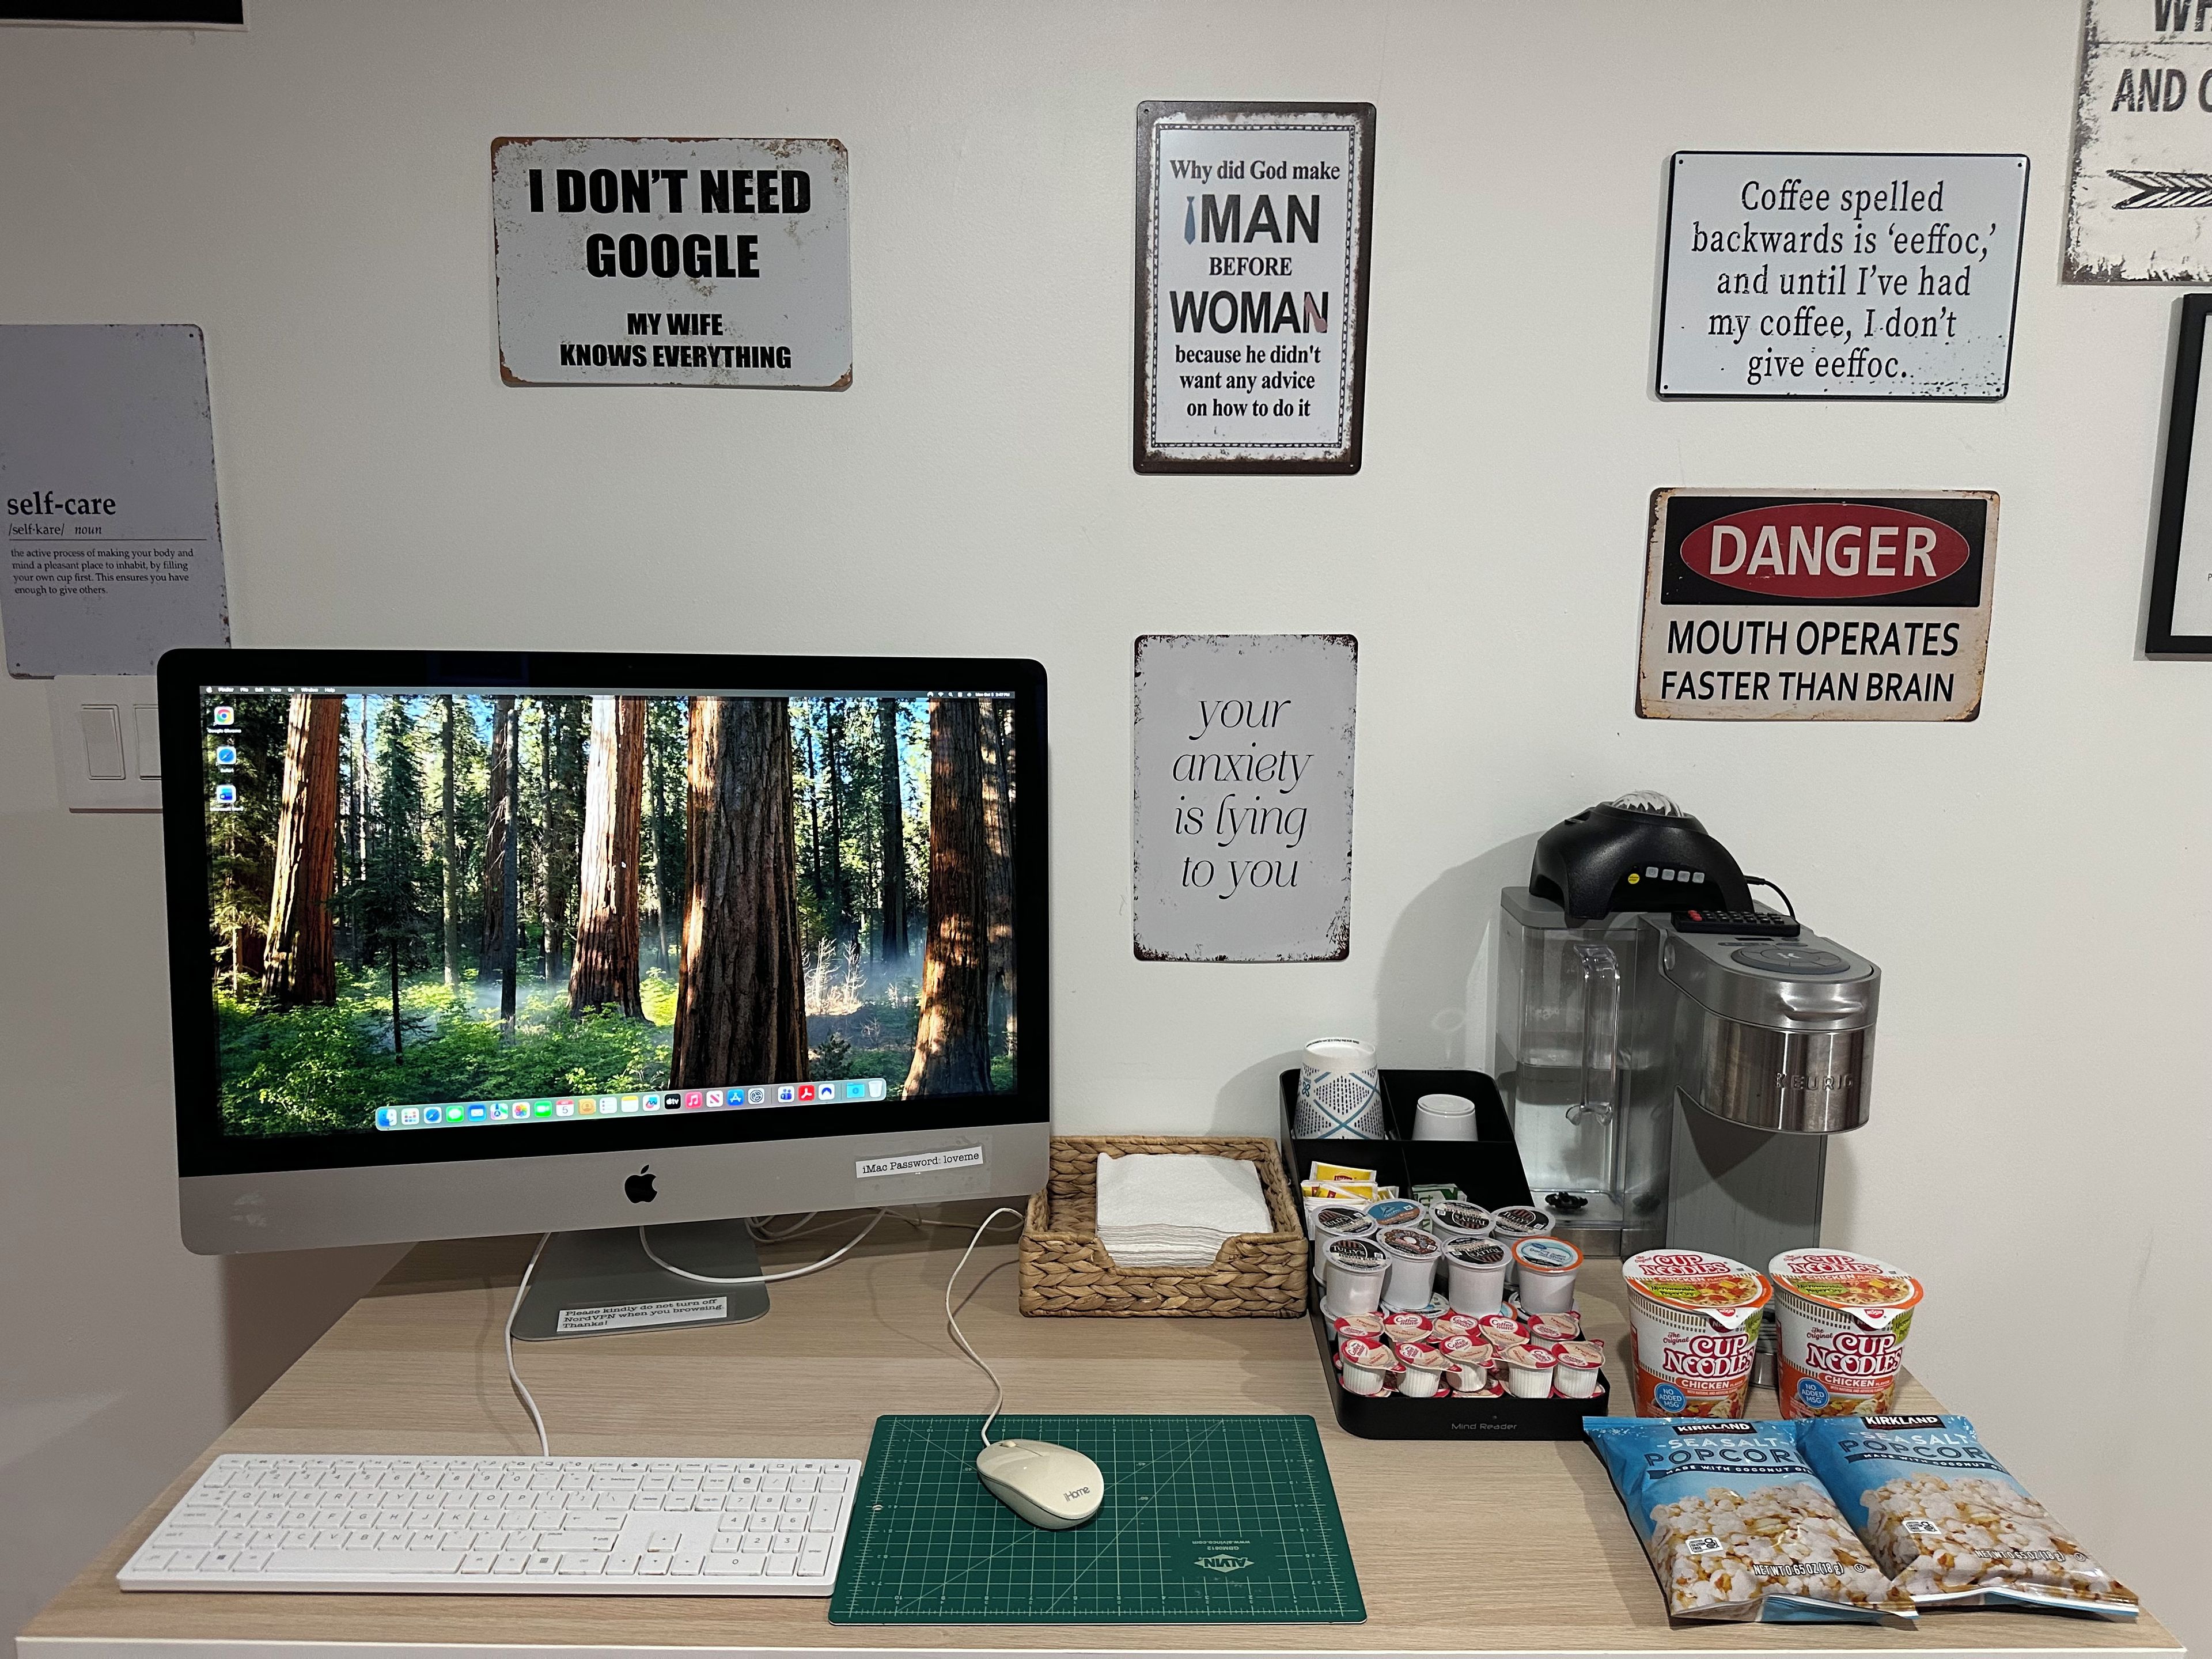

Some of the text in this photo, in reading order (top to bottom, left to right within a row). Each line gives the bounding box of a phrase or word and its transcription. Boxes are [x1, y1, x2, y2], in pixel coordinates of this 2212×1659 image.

[2111, 69, 2187, 112] AND
[1170, 160, 1340, 183] Why did God make
[529, 168, 810, 214] I DON'T NEED
[1741, 179, 1944, 220] Coffee spelled
[1202, 194, 1320, 243] MAN
[1692, 221, 1997, 262] backwards is 'eeffoc,'
[586, 234, 760, 278] GOOGLE
[1209, 257, 1292, 276] BEFORE
[1717, 264, 1971, 295] and until I've had
[1170, 291, 1328, 334] WOMAN
[628, 313, 724, 336] MY WIFE
[1709, 305, 1957, 344] my coffee, I don't
[560, 345, 791, 369] KNOWS EVERYTHING
[1175, 345, 1321, 363] because he didn't
[1747, 347, 1804, 385] give
[1180, 371, 1316, 393] want any advice
[1187, 399, 1310, 416] on how to do it
[7, 491, 116, 515] self-care
[75, 526, 102, 535] noun
[54, 551, 84, 559] process
[86, 548, 96, 557] of
[97, 549, 129, 559] making
[131, 551, 151, 559] your
[153, 549, 173, 559] body
[177, 548, 194, 557] and
[1709, 525, 1938, 577] DANGER
[44, 561, 79, 571] pleasant
[81, 562, 103, 571] place
[116, 562, 148, 571] inhabit,
[150, 561, 161, 571] by
[163, 561, 188, 571] filling
[13, 575, 33, 584] your
[57, 575, 72, 584] cup
[74, 573, 94, 581] first.
[95, 573, 114, 581] This
[150, 575, 167, 584] you
[169, 573, 189, 581] have
[15, 586, 108, 596] enough to give others.
[1668, 620, 1960, 656] MOUTH OPERATES
[1661, 671, 1955, 702] FASTER THAN BRAIN
[1188, 699, 1291, 740] your
[1173, 742, 1314, 794] anxiety
[1175, 793, 1307, 849] is lying
[1181, 857, 1298, 899] to you
[1776, 1073, 1853, 1090] KEURIG
[862, 1153, 979, 1173] iMac Password: loveme
[1332, 1245, 1365, 1255] TULLY'S
[1639, 1262, 1730, 1275] NOODLES
[1653, 1255, 1703, 1266] CUP
[1787, 1263, 1883, 1274] NOODLES
[1803, 1255, 1854, 1264] CUP
[563, 1313, 616, 1322] NordVPN
[1396, 1316, 1418, 1324] Coffee
[1491, 1319, 1514, 1328] Coffee
[1447, 1339, 1467, 1348] Coffee
[1663, 1334, 1749, 1357] Original CUP
[1806, 1332, 1896, 1355] Original CUP
[1663, 1347, 1755, 1378] NOODLES
[1806, 1343, 1902, 1376] NOODLES
[1681, 1380, 1729, 1389] CHICKEN
[1824, 1375, 1874, 1387] CHICKEN
[1659, 1394, 1682, 1402] ADDED
[1451, 1422, 1477, 1430] Mind
[1677, 1423, 1750, 1431] KIRKLAND
[1866, 1416, 1938, 1425] KIRKLAND
[1668, 1438, 1778, 1448] SEA SALT
[1861, 1432, 1968, 1445] SEA SALT
[1666, 1465, 1696, 1475] MADE
[1203, 1558, 1247, 1567] ALVIN
[1753, 1562, 1844, 1576] NET WT 0.65 OZ (18 g)
